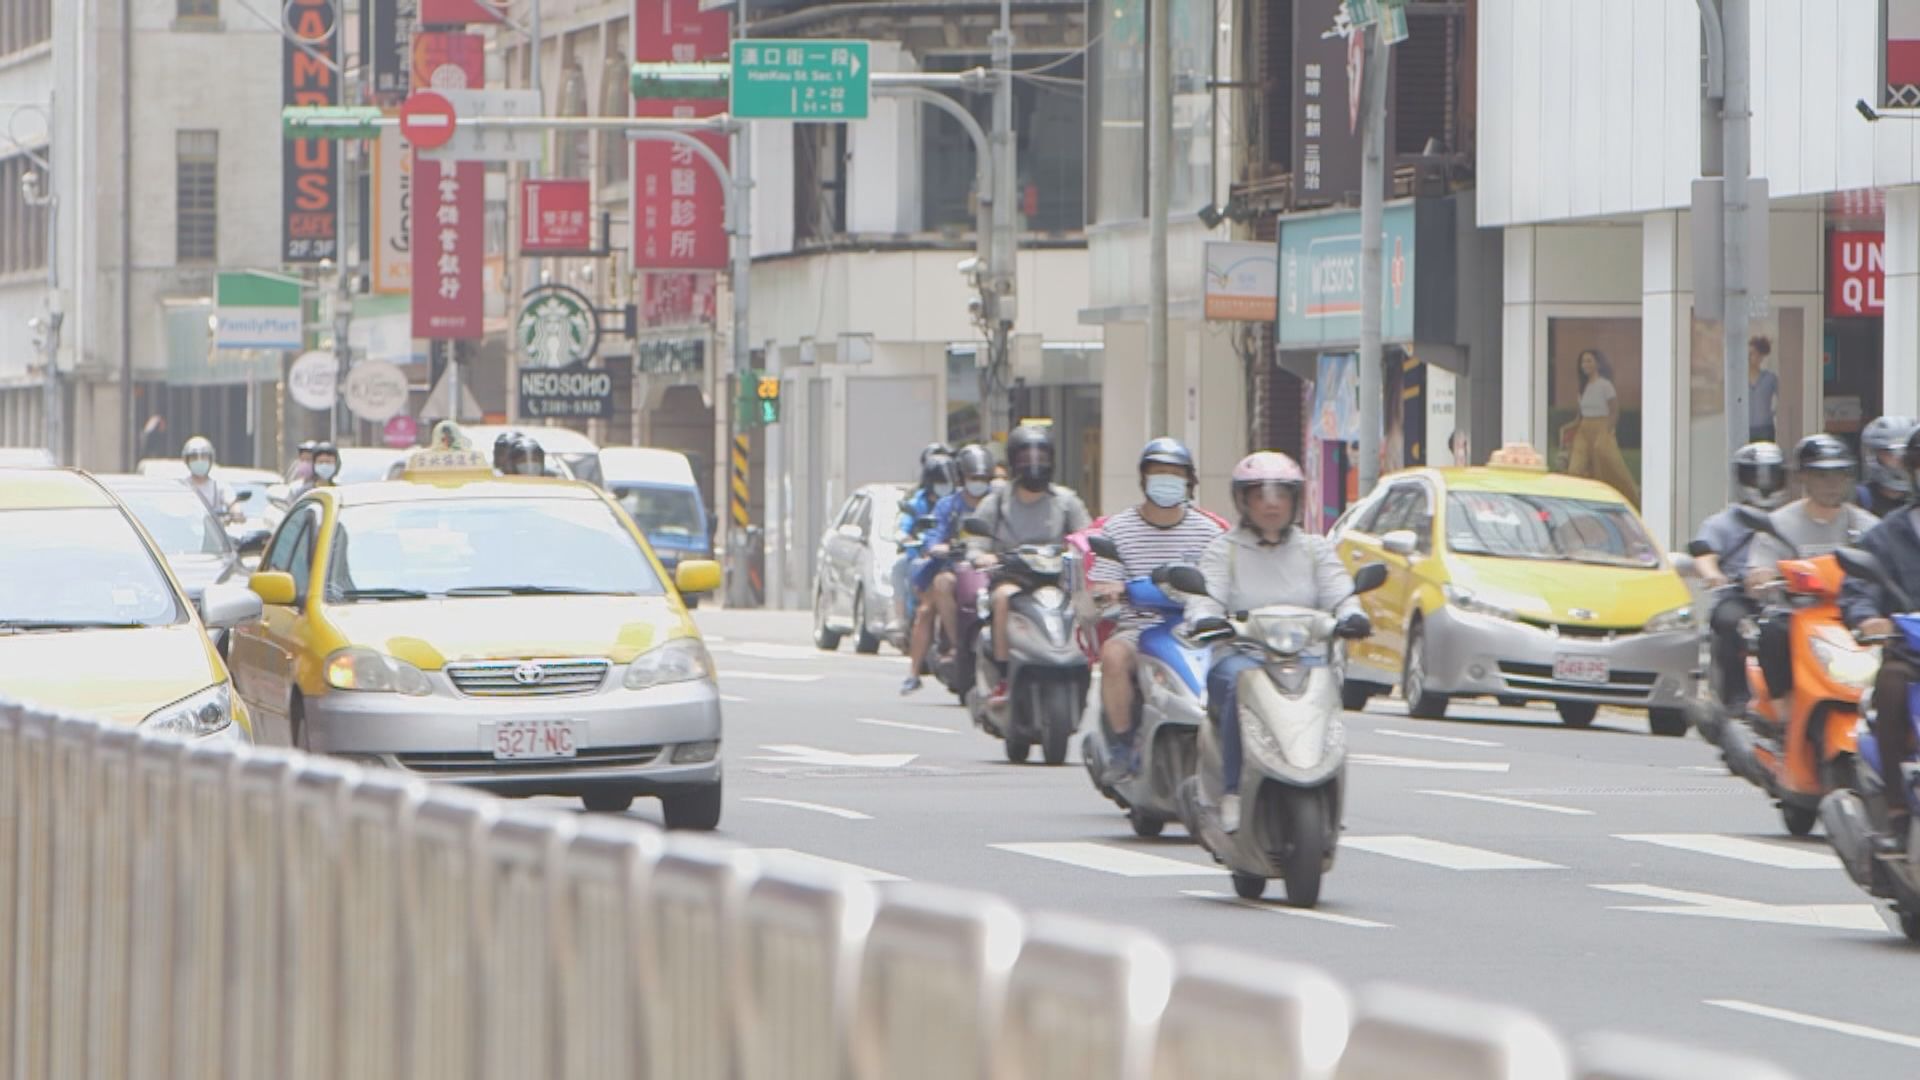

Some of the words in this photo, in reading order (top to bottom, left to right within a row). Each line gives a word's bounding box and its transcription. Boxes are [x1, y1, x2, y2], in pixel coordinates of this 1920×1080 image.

[741, 48, 848, 66] 漢口街一段
[294, 0, 331, 210] AMUS
[218, 317, 298, 335] FamilyMart
[522, 372, 611, 397] NEOSOHO
[497, 727, 573, 753] 527-NC
